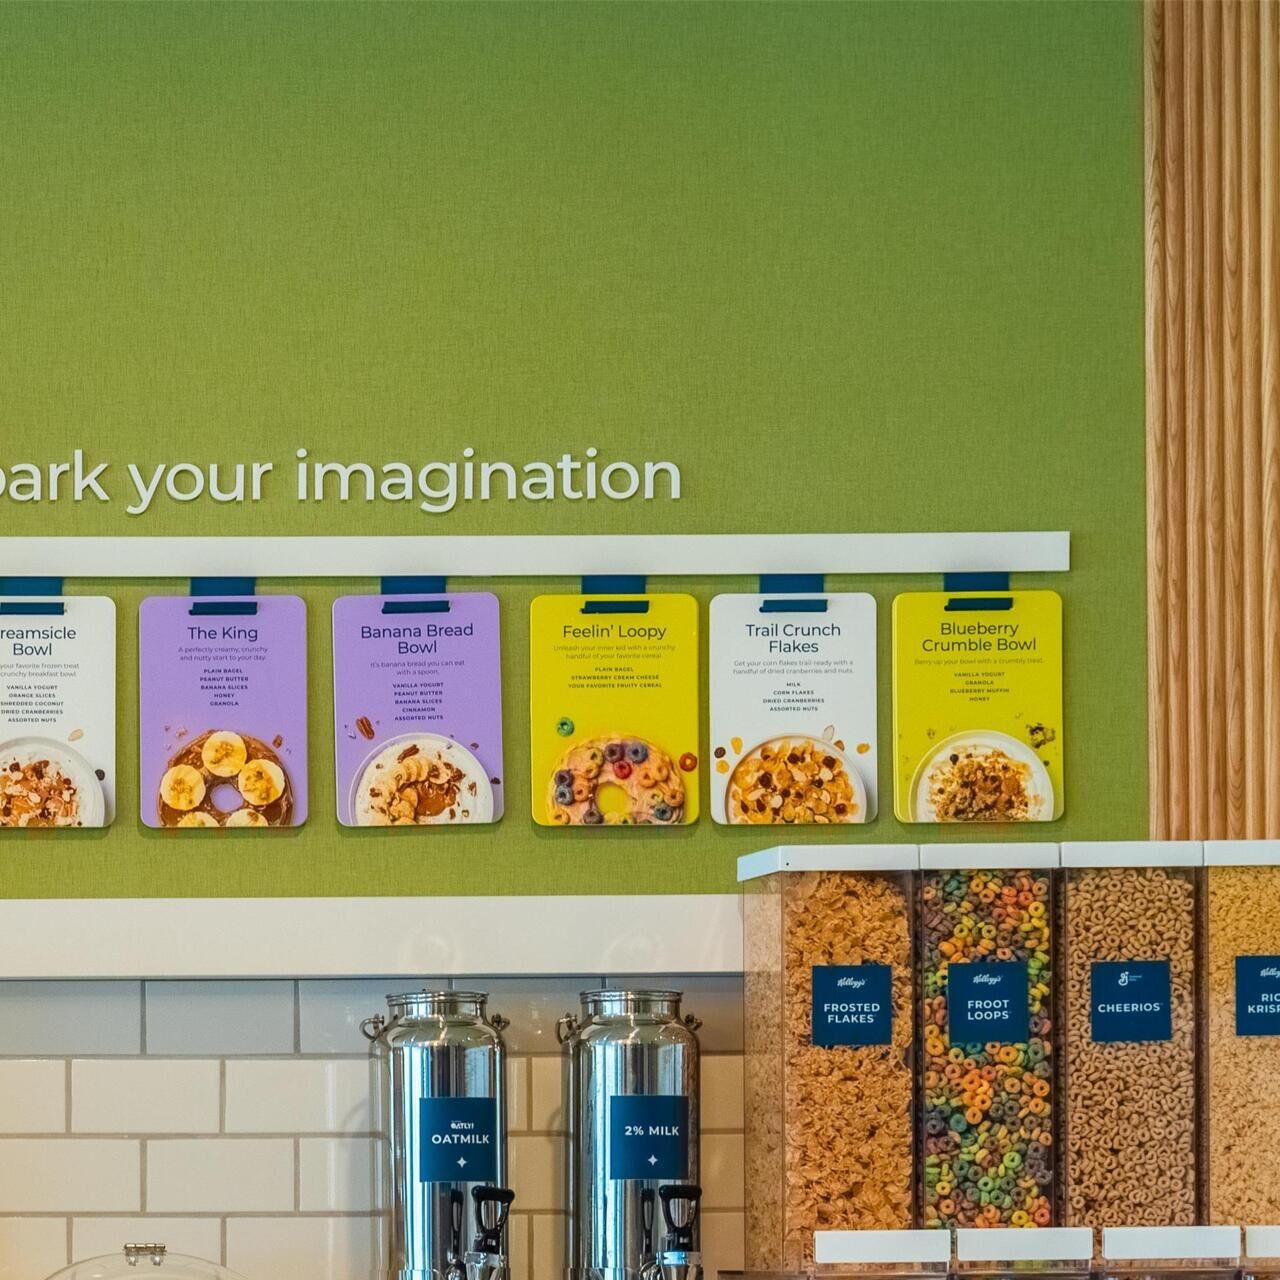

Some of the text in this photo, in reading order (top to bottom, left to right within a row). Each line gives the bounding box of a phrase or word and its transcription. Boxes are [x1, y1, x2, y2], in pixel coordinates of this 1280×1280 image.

[126, 460, 272, 514] your
[294, 447, 682, 512] imagination
[187, 626, 258, 642] The King
[361, 623, 473, 639] Banana Bread
[563, 624, 667, 640] Feelin' Loopy
[745, 623, 841, 637] Trail Crunch
[940, 622, 1019, 637] Blueberry
[13, 643, 52, 656] Bowl
[398, 640, 437, 654] Bowl
[769, 640, 819, 653] Flakes
[922, 637, 1036, 652] Crumble Bowl
[823, 1003, 880, 1013] FROSTED
[968, 1000, 1009, 1009] FROOT
[1098, 1003, 1161, 1013] CHEERIOS
[828, 1014, 874, 1024] FLAKES
[968, 1011, 1009, 1020] LOOPS
[624, 1126, 679, 1136] 2% MILK
[432, 1134, 489, 1144] OATMILK
